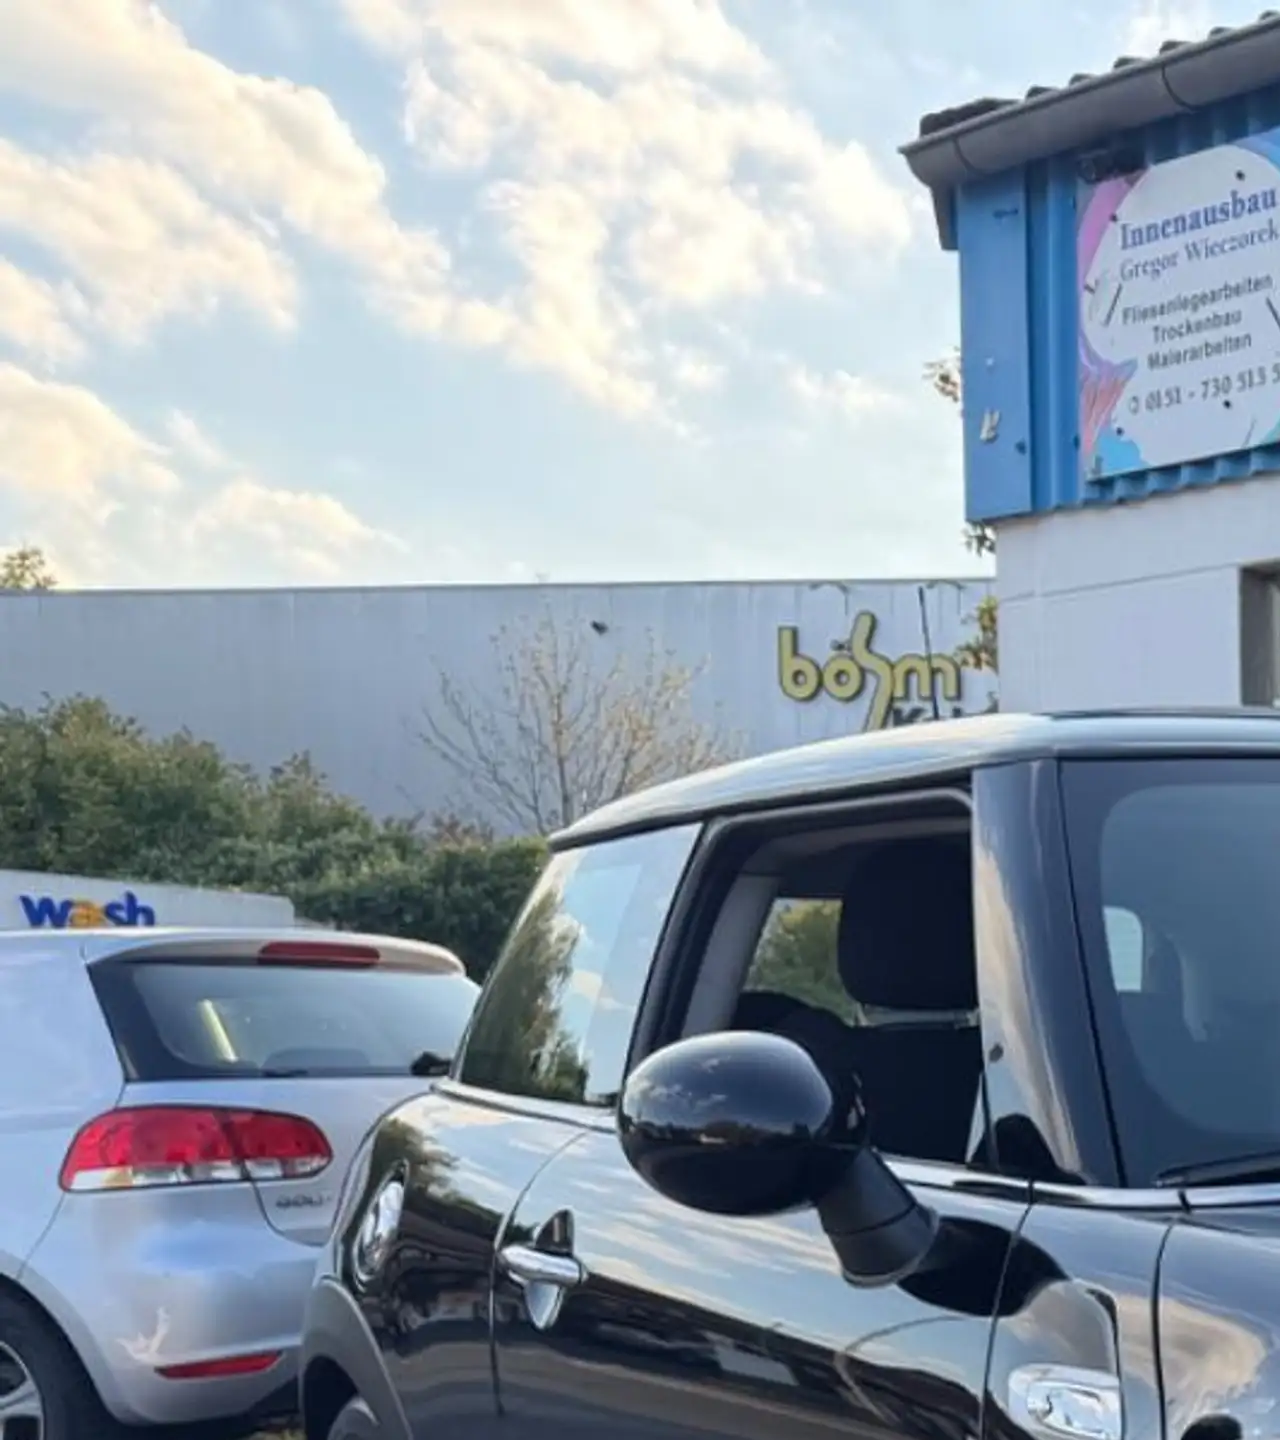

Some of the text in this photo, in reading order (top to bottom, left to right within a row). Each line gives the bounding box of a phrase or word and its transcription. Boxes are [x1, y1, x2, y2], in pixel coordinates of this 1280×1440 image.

[1121, 187, 1278, 251] Innenausbau
[1120, 252, 1179, 282] Gregor
[1152, 309, 1242, 344] Trockenbau
[20, 890, 156, 928] wash
